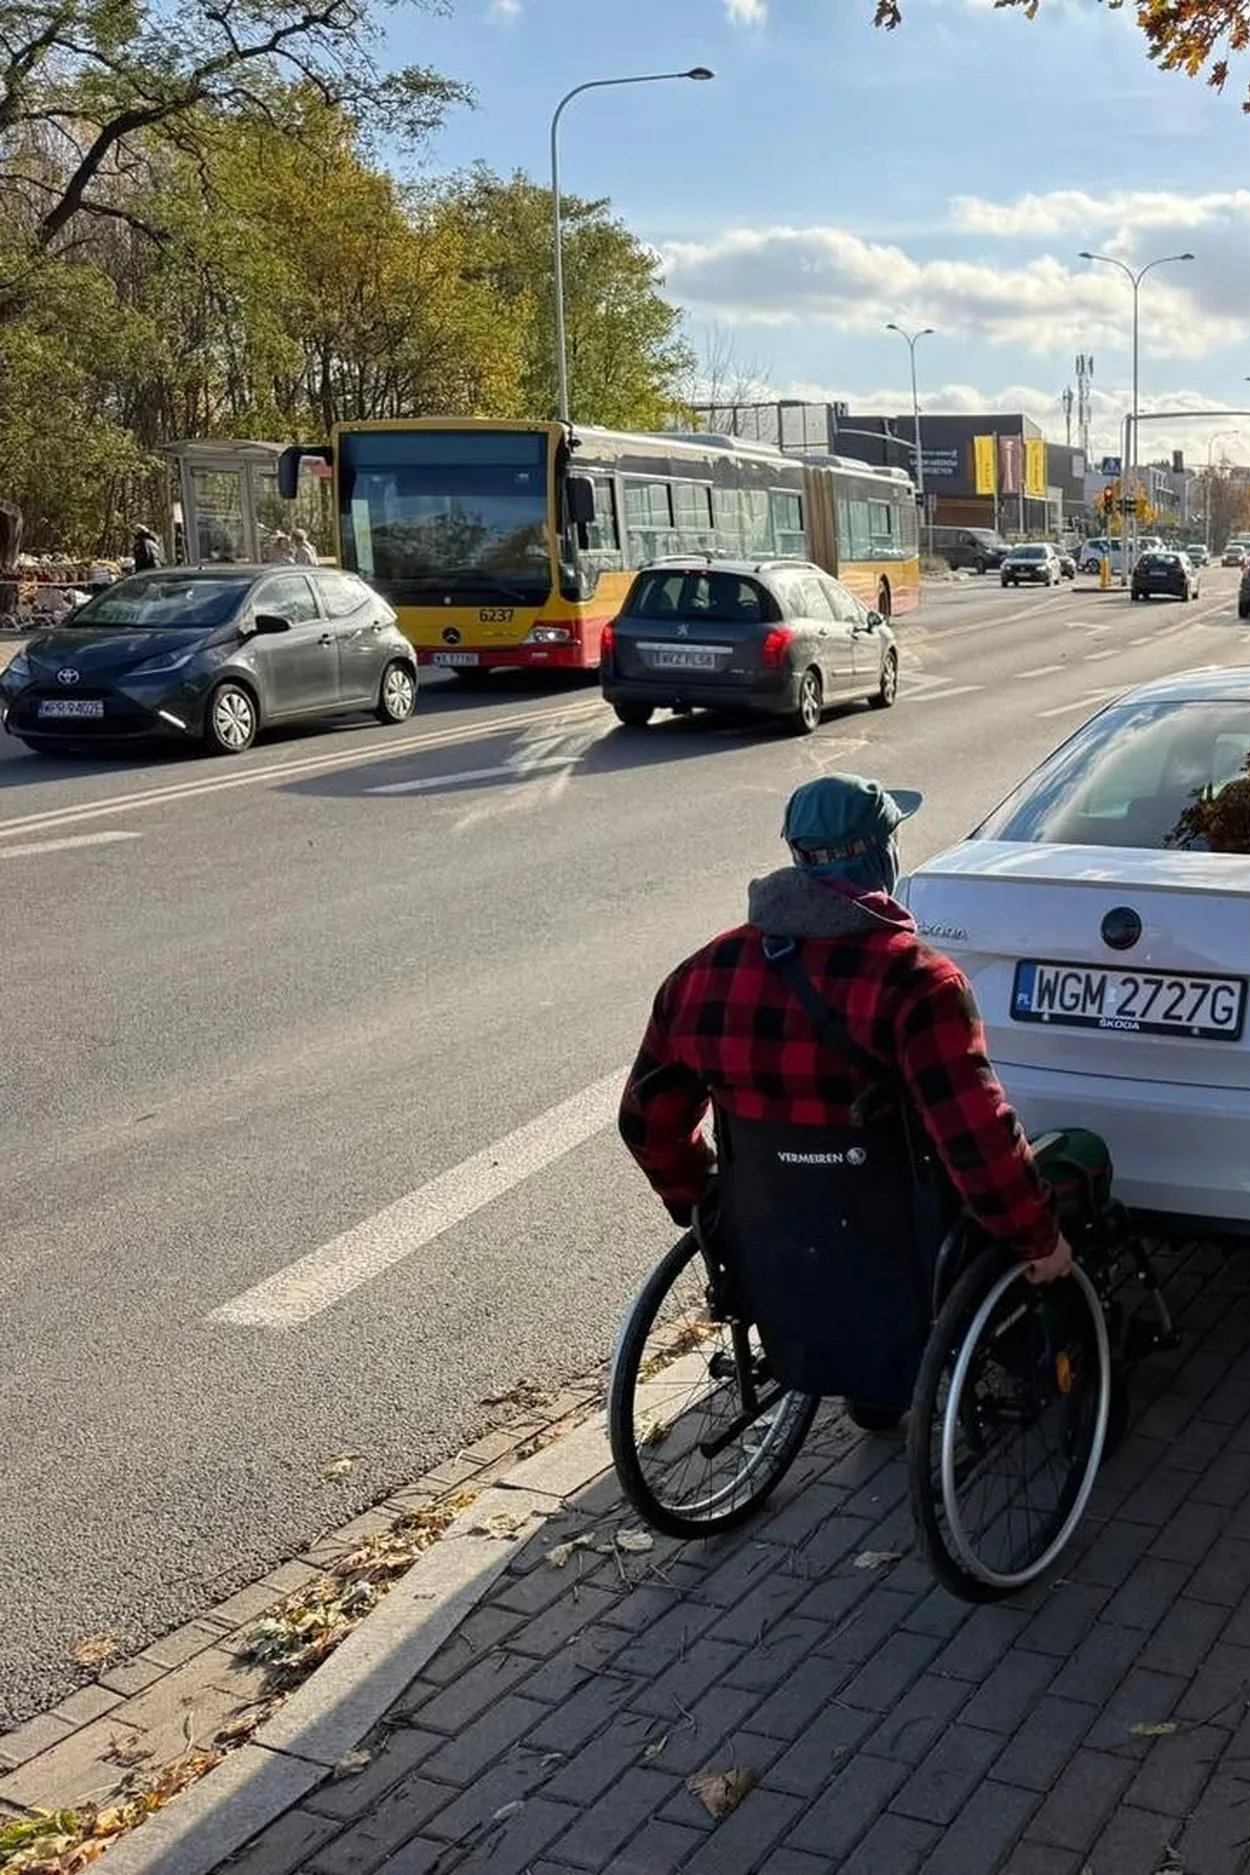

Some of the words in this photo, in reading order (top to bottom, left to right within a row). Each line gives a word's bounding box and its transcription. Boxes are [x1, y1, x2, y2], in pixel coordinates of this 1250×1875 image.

[480, 608, 514, 622] 6237
[1017, 993, 1030, 1004] PL
[1037, 969, 1107, 1015] WGM
[1116, 976, 1236, 1026] 2727G
[777, 1151, 844, 1163] VERMEIREN
